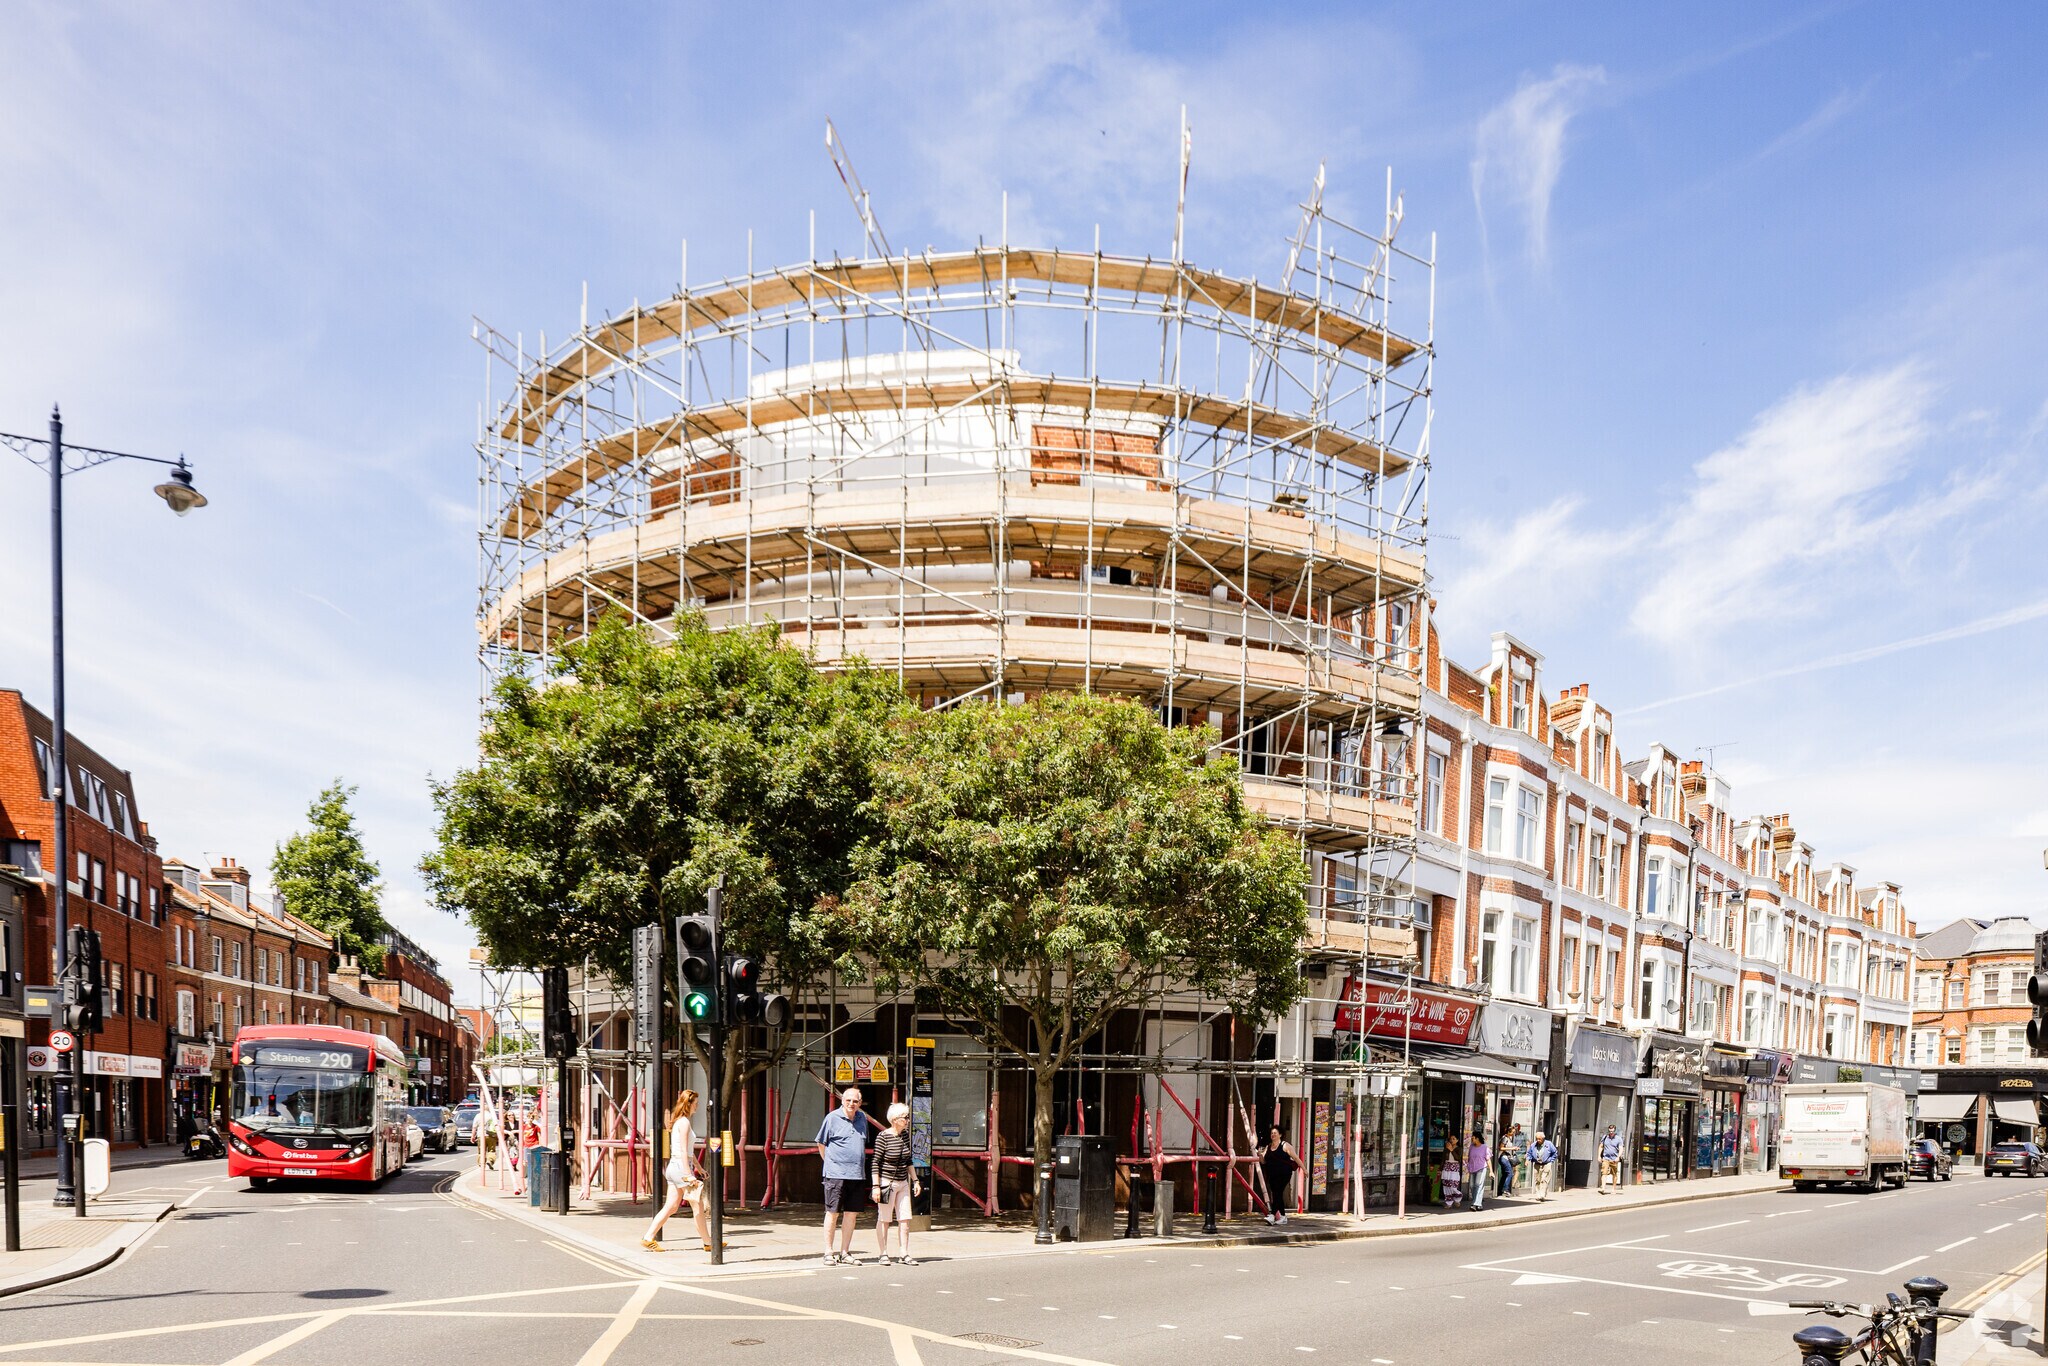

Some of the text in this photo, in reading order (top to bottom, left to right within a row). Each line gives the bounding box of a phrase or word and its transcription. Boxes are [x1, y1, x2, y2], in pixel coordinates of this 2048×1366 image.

[1345, 1011, 1361, 1020] WLL'S
[1419, 999, 1428, 1019] &
[1428, 1001, 1449, 1021] WINE
[53, 1036, 70, 1046] 20
[270, 1051, 352, 1068] Staines 290
[1592, 1046, 1620, 1062] Lisa's Nails
